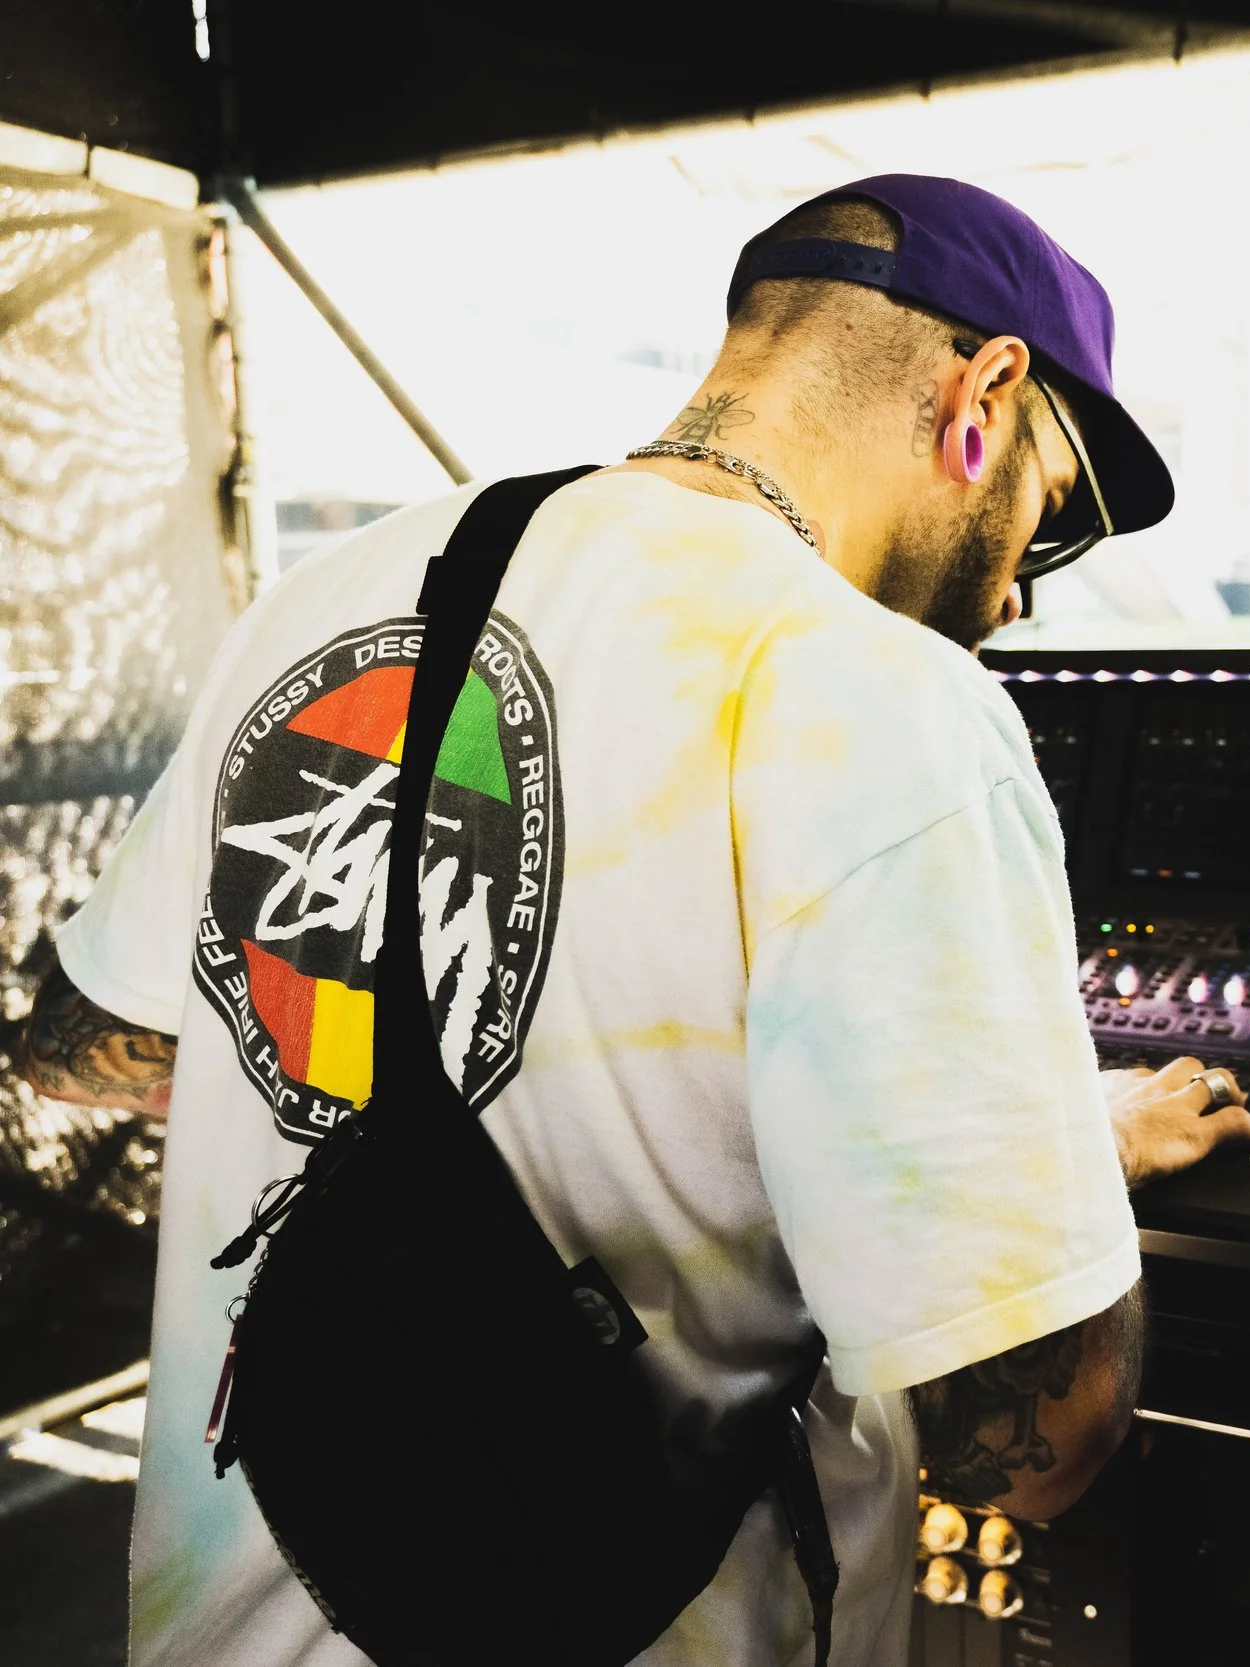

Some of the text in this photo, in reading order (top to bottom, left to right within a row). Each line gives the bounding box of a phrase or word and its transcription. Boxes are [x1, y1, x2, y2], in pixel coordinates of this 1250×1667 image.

[228, 663, 325, 780] STUSSY
[354, 635, 424, 669] DES
[473, 633, 534, 727] ROOTS
[507, 755, 545, 933] REGGAE
[255, 1045, 300, 1108] JH
